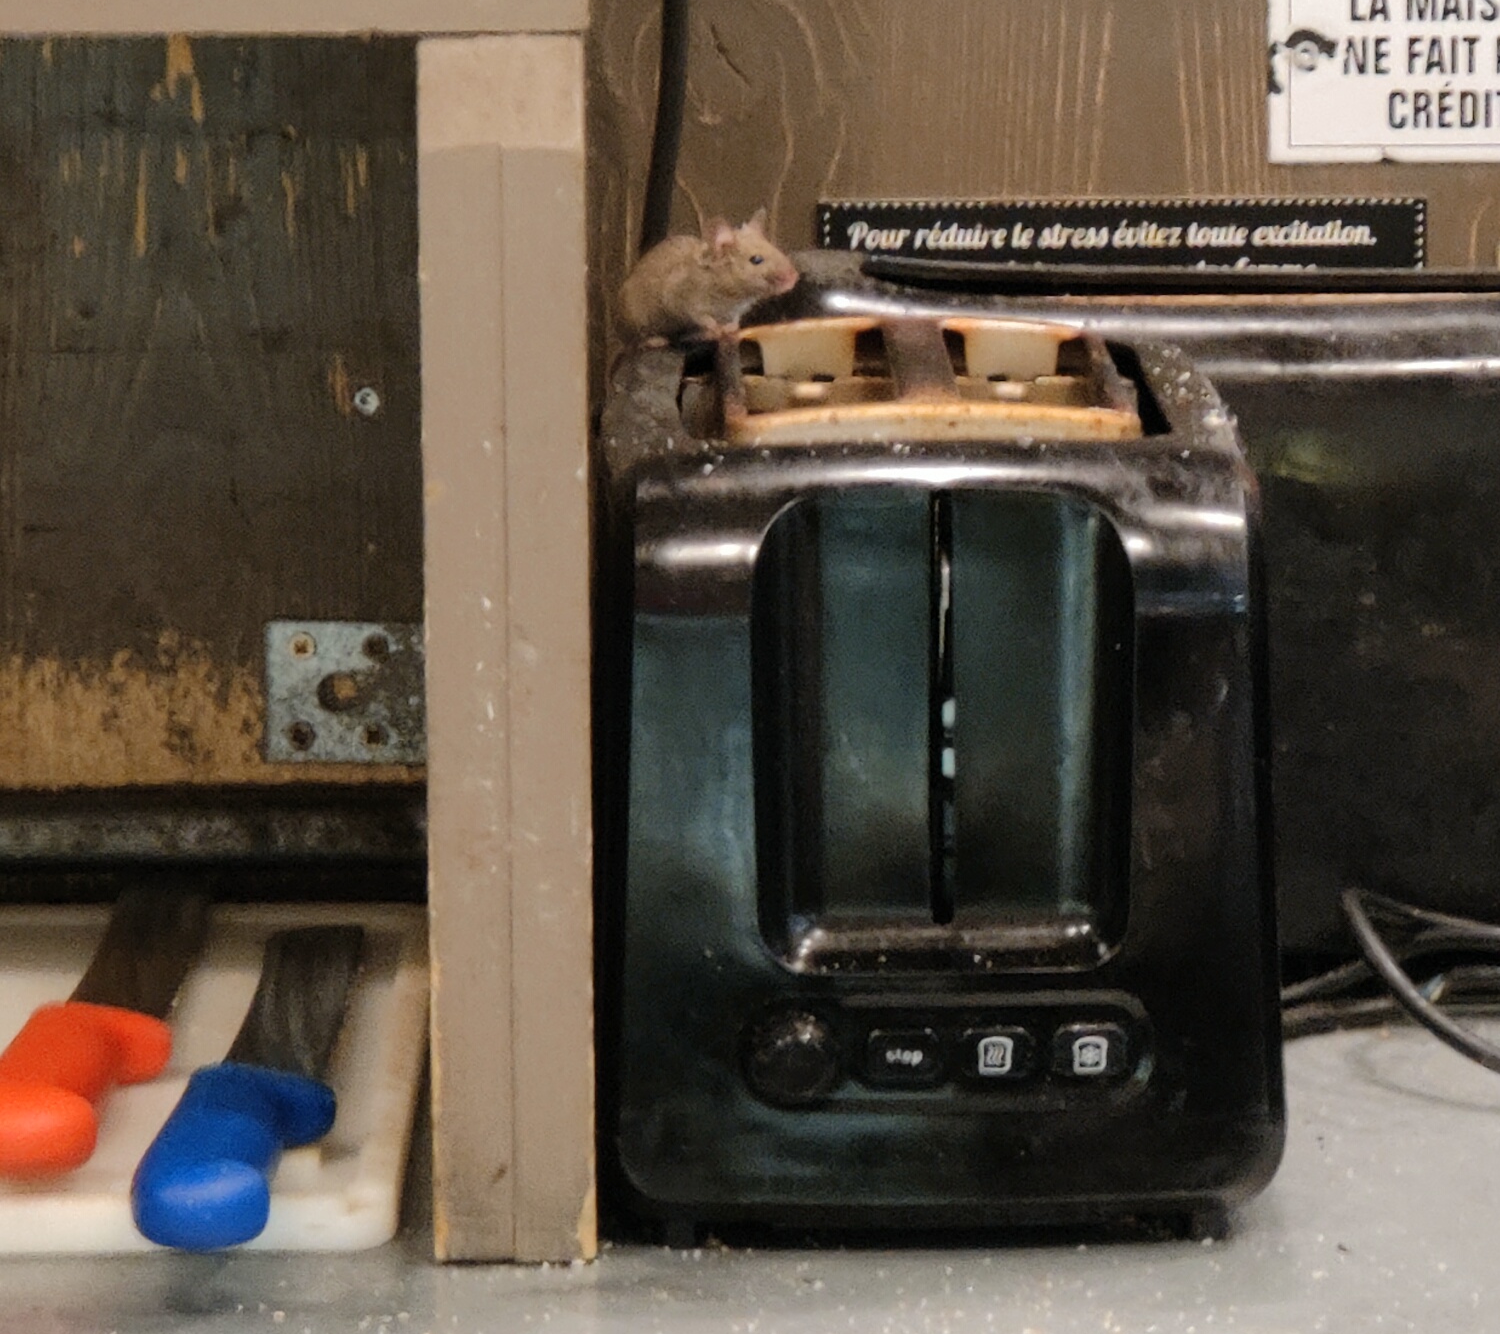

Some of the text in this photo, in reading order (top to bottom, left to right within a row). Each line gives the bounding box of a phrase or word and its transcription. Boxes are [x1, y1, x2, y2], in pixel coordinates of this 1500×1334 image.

[1342, 36, 1392, 76] NE
[1406, 35, 1481, 76] FAIT
[847, 218, 1379, 252] Pour réduire le stress évitez toute excitation.
[885, 1048, 924, 1067] stop
